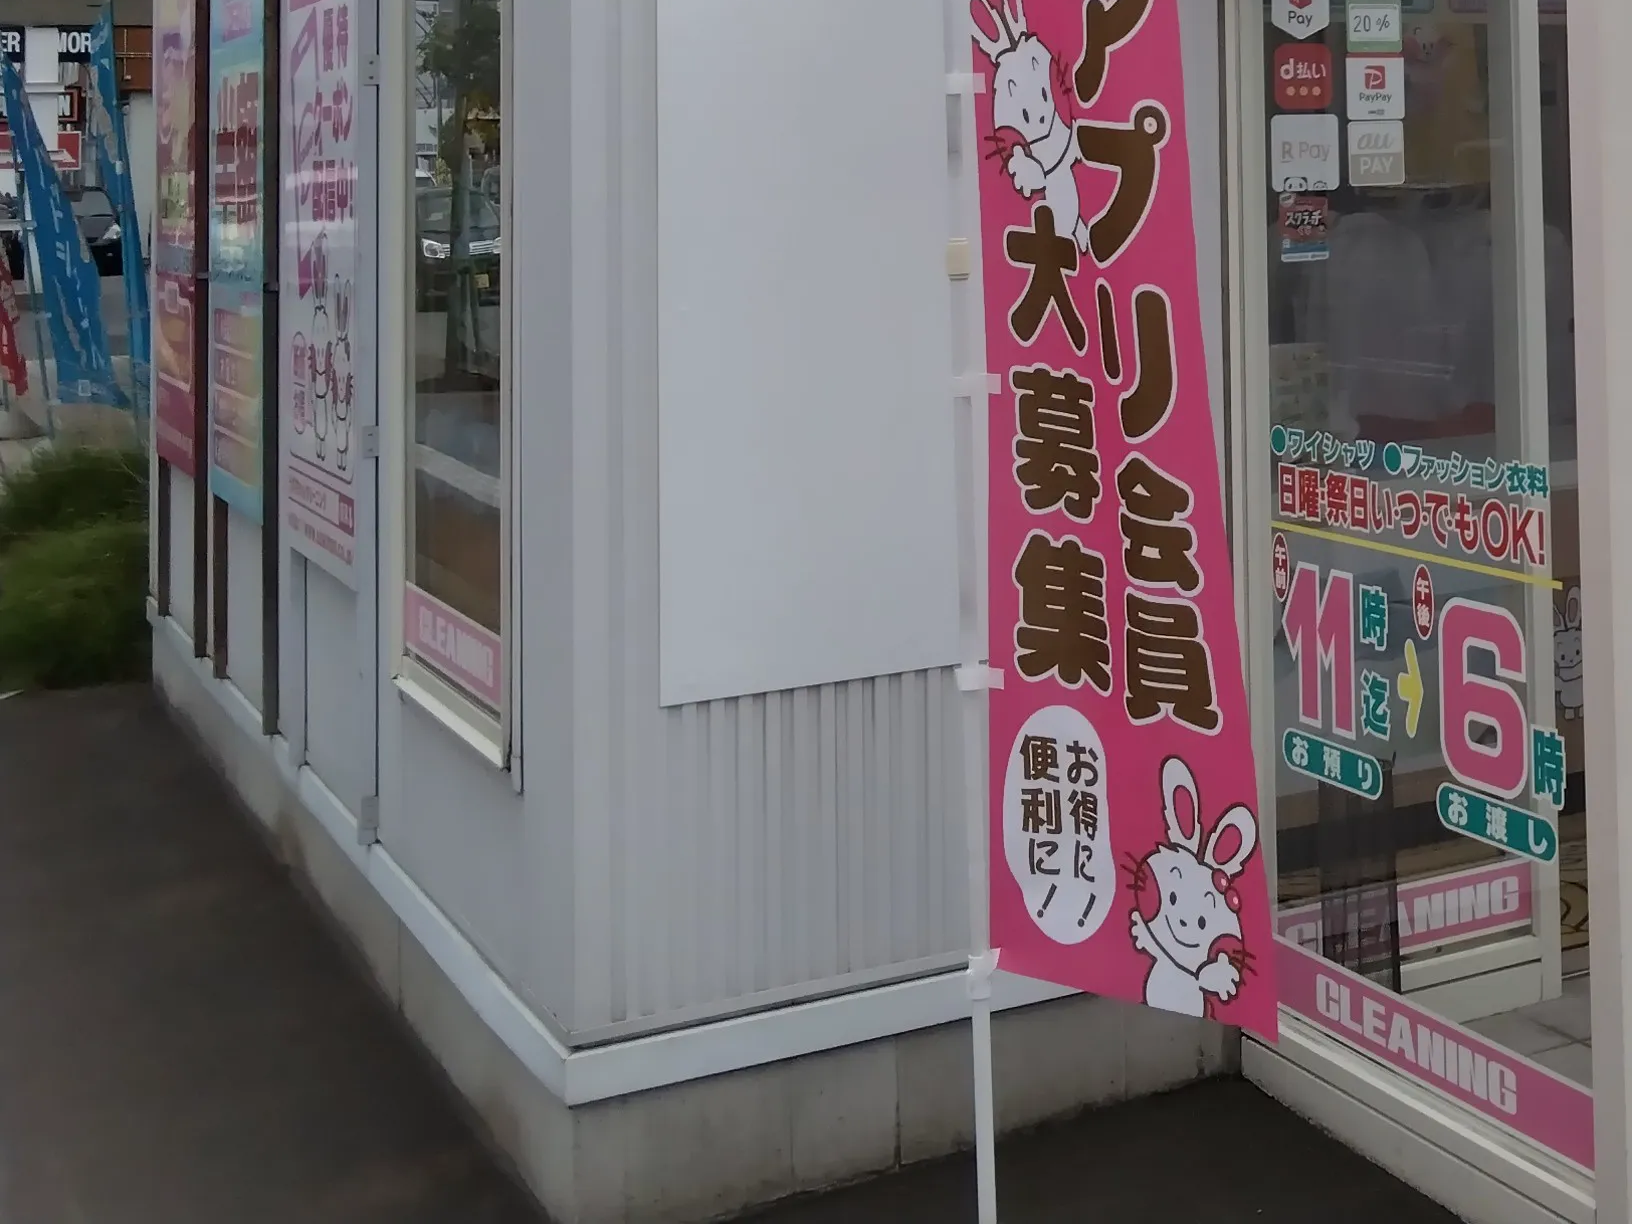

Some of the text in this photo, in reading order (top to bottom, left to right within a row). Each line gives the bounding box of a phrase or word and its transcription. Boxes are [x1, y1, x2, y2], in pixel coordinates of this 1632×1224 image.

[1287, 10, 1313, 27] Pay
[1280, 57, 1327, 80] d払い
[1359, 92, 1392, 102] PayPay
[1359, 156, 1393, 174] PAY
[1003, 201, 1114, 698] 大募集
[1286, 427, 1550, 499] ワイシャツ ファッション衣料
[1281, 561, 1356, 741] 11
[1438, 596, 1528, 800] 6
[1530, 723, 1567, 811] 時
[1316, 973, 1517, 1116] CLEANING
